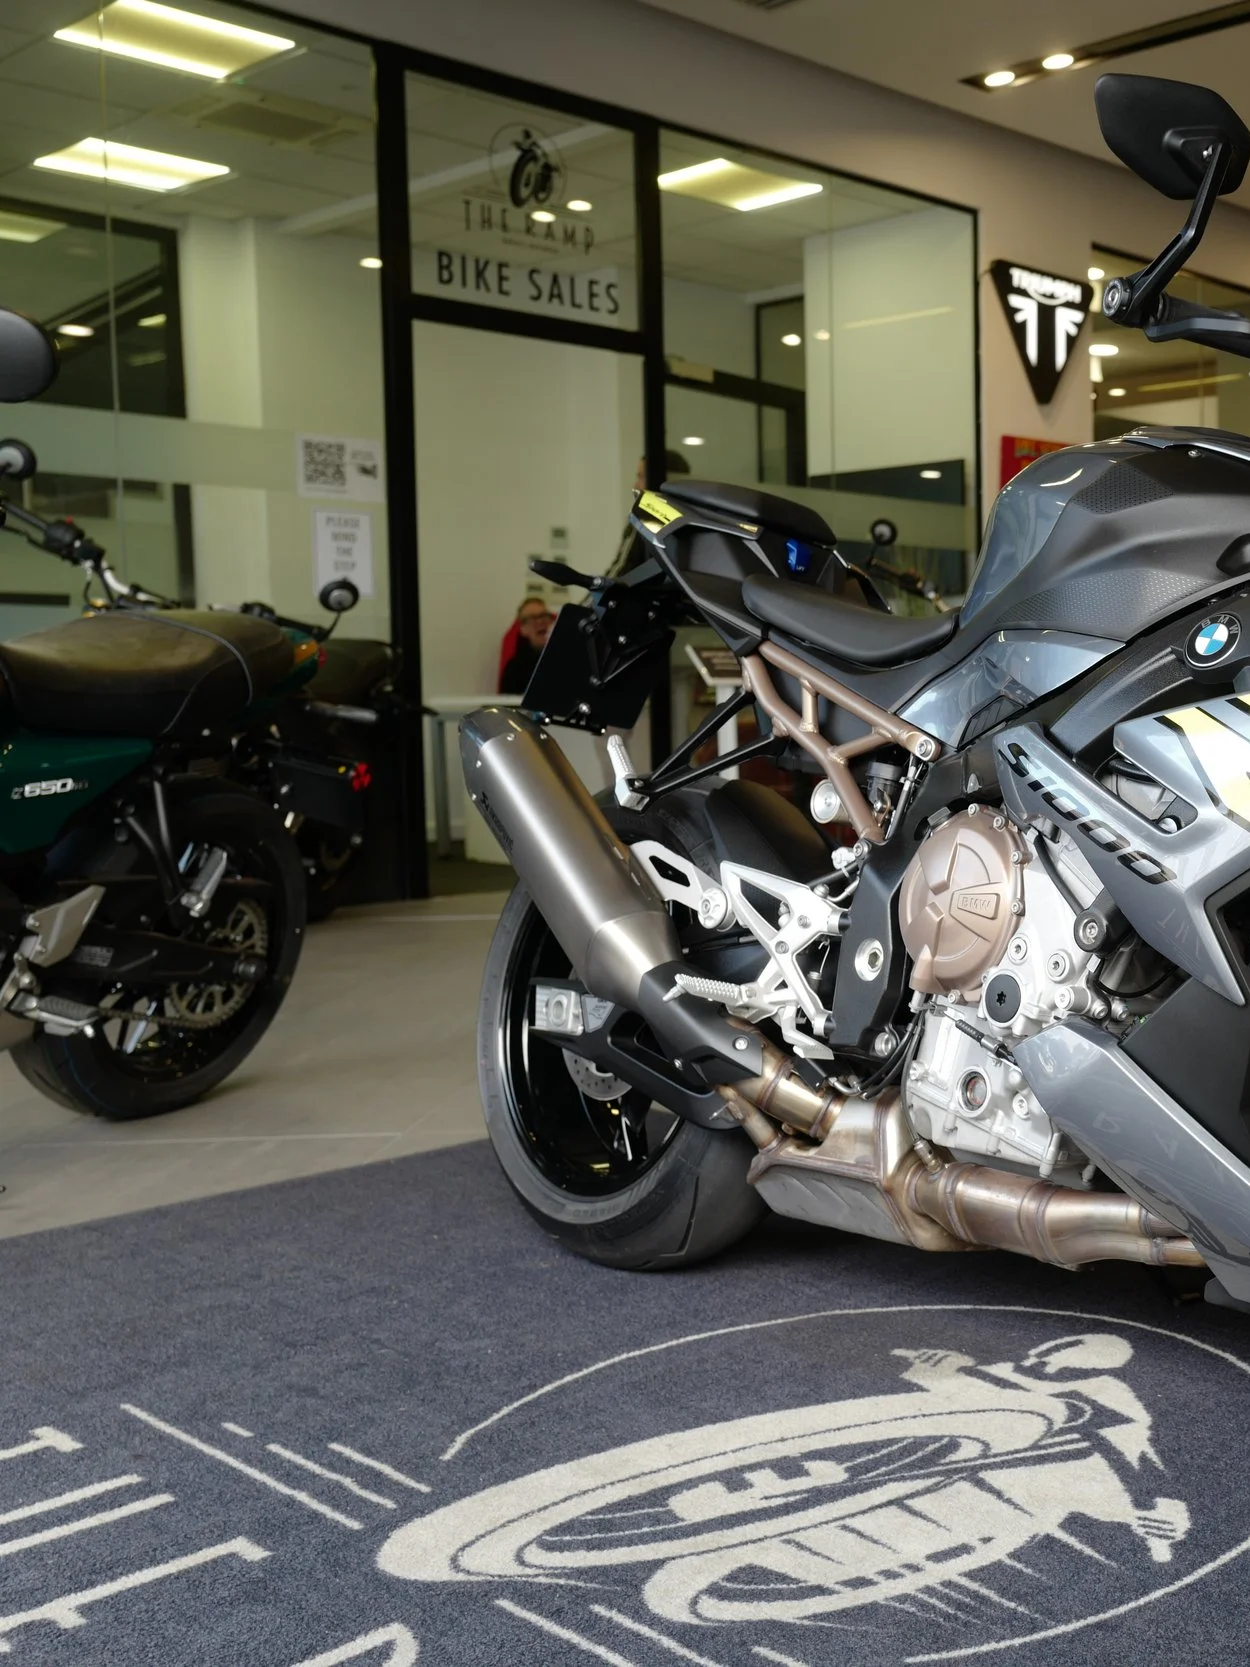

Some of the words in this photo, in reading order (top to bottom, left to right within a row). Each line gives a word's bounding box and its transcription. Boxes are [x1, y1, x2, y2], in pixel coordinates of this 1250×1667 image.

[461, 199, 510, 233] THE
[524, 214, 595, 255] RAMP
[436, 251, 511, 297] BIKE
[527, 267, 620, 316] SALES
[1009, 266, 1083, 304] TRIUMPH
[1201, 614, 1239, 635] BMW
[998, 742, 1178, 885] S1000
[962, 896, 991, 911] BMW
